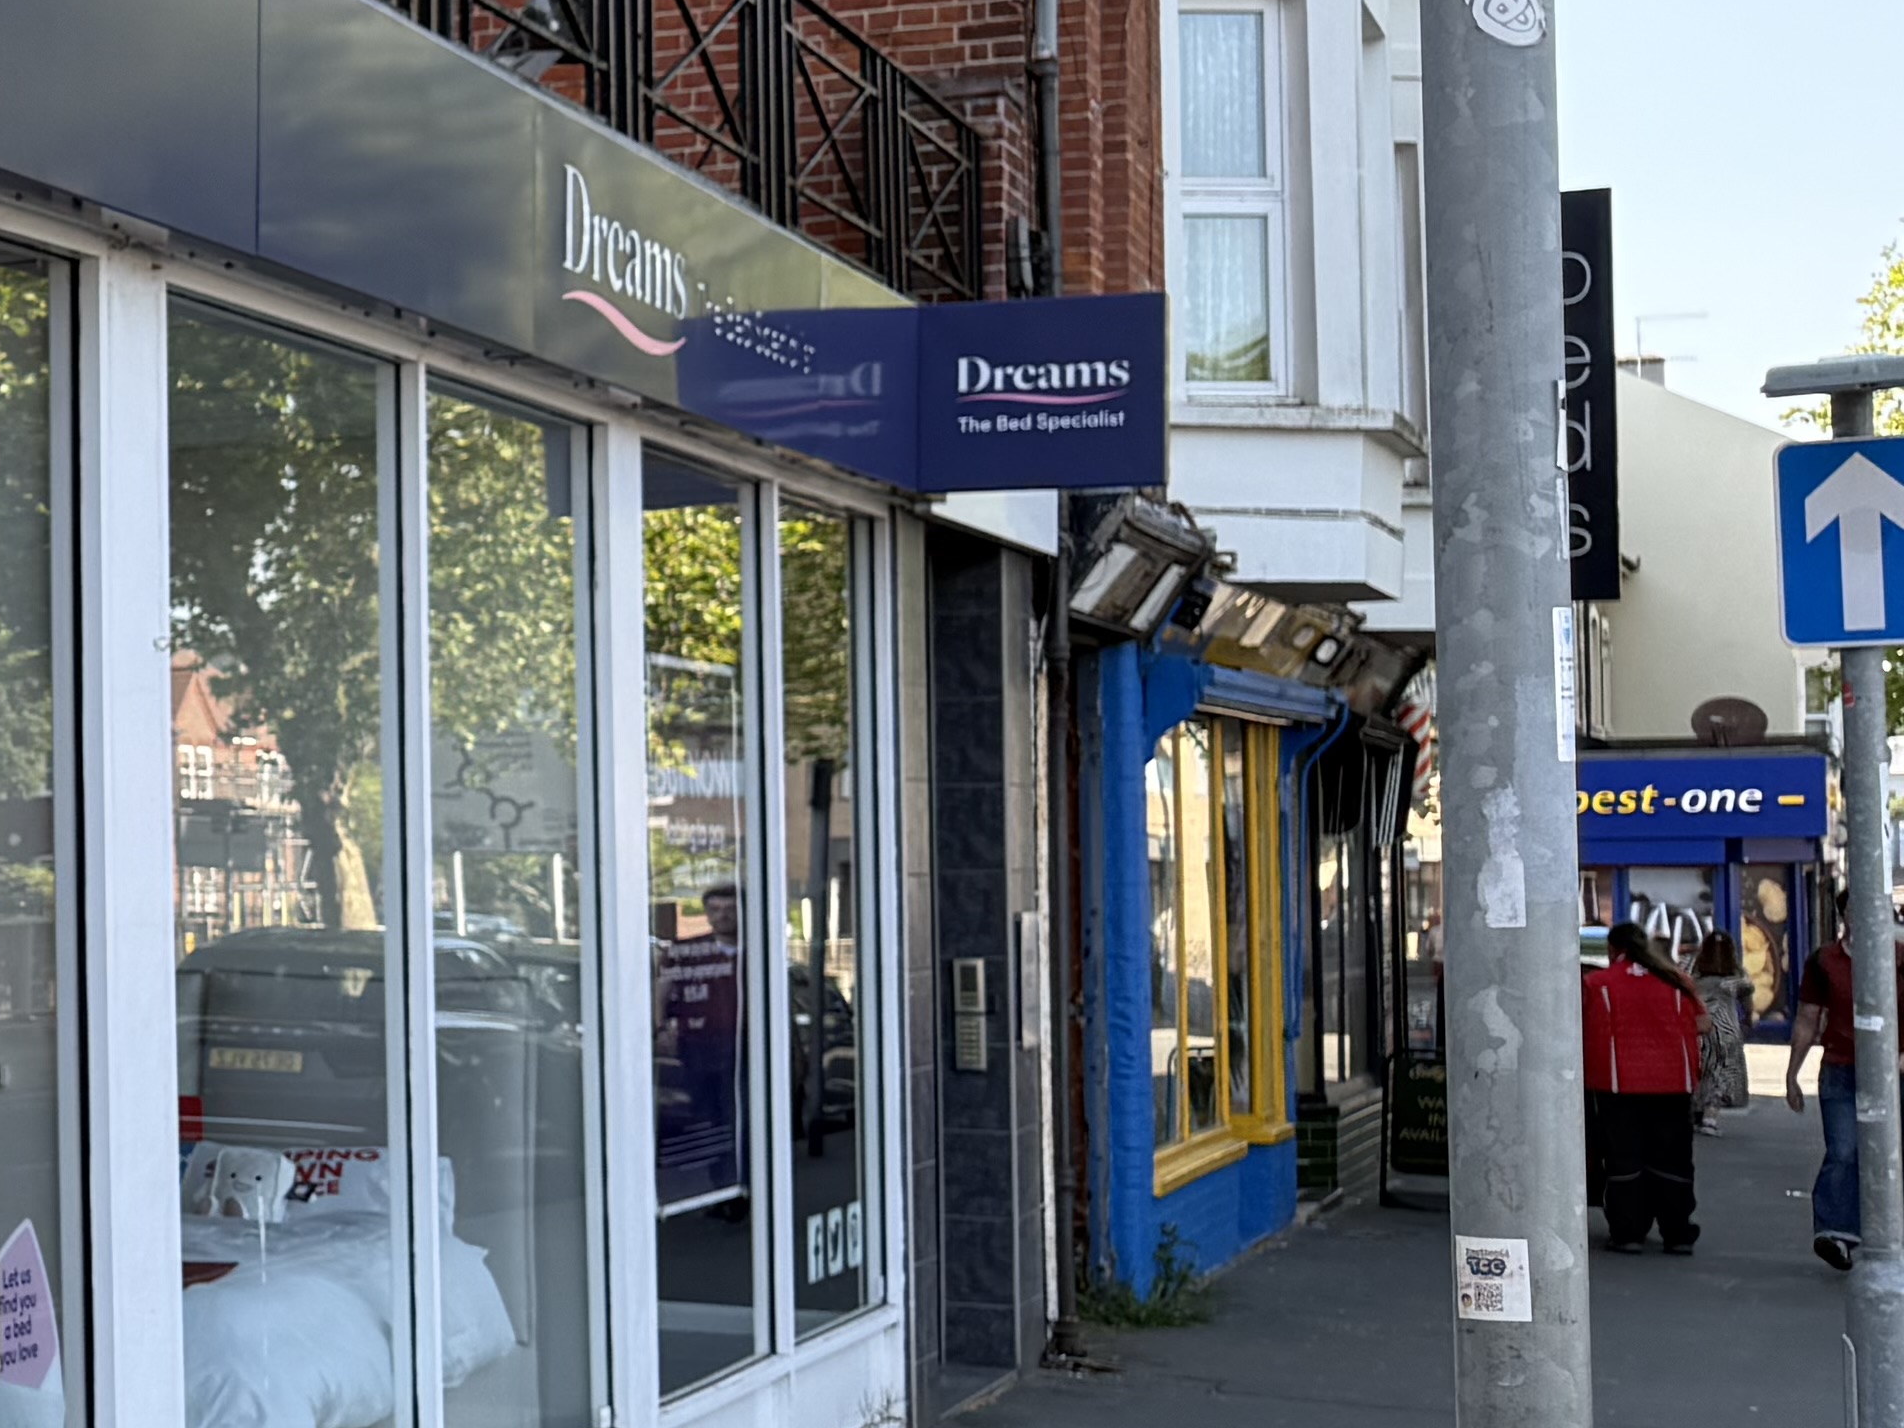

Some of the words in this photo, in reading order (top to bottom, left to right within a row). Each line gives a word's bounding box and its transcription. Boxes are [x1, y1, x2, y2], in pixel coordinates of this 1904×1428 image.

[563, 164, 688, 320] Dreams
[957, 356, 1130, 394] Dreams
[957, 414, 991, 434] The
[995, 413, 1032, 432] Bed
[1036, 410, 1126, 434] Specialist
[2, 1267, 19, 1290] Let
[20, 1268, 32, 1286] us
[19, 1292, 37, 1317] you
[12, 1318, 33, 1339] bed
[0, 1349, 17, 1373] you
[18, 1342, 39, 1362] love
